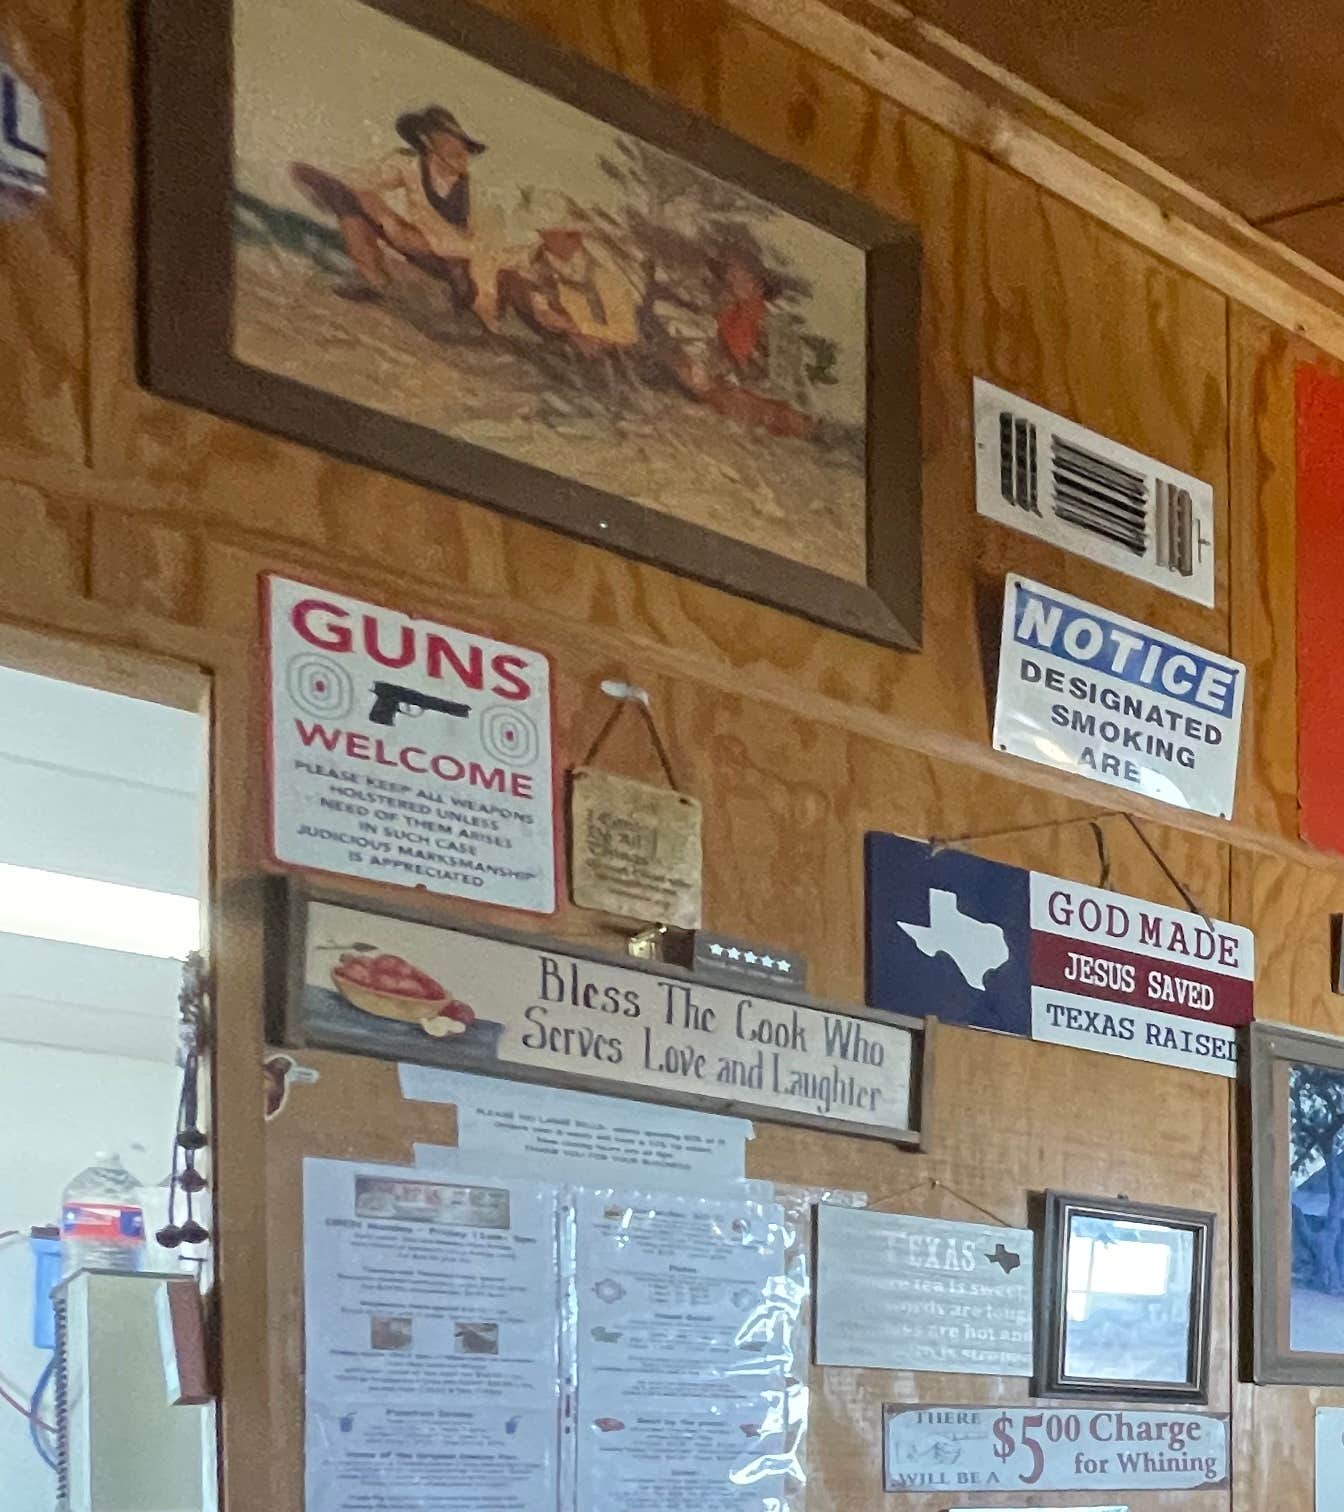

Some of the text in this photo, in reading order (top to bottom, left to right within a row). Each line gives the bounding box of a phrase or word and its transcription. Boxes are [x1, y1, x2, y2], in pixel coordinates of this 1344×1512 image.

[289, 598, 532, 702] GUNS
[1017, 598, 1233, 711] NOTICE
[1020, 658, 1223, 746] DESIGNATED
[293, 717, 534, 800] WELCOME
[1051, 703, 1197, 770] SMOKING
[294, 758, 534, 826] PLEASE KEEP ALL WEAPONS
[1077, 746, 1143, 785] ARE
[319, 796, 514, 850] NEED OF THEM ARISES
[329, 784, 500, 832] HOLSTERED UNLESS
[296, 823, 539, 881] JUDICIOUS MARKSMANSHIP
[358, 821, 479, 856] IN SUCH CASE
[346, 851, 485, 889] IS APPRECIATED
[1047, 890, 1240, 968] GOD MADE
[1063, 951, 1215, 1011] JESUS SAVED
[538, 955, 642, 1019] Bless
[657, 980, 717, 1034] The
[735, 999, 808, 1053] Cook
[822, 1014, 886, 1068] Who
[1046, 1002, 1135, 1040] TEXAS
[521, 1004, 884, 1115] Serves Love and Laughter
[881, 1229, 978, 1273] TEXAS
[916, 1410, 982, 1426] THERE
[1088, 1412, 1202, 1452] Charge
[898, 1471, 1001, 1487] WILL BE A
[1074, 1452, 1218, 1480] for Whining
